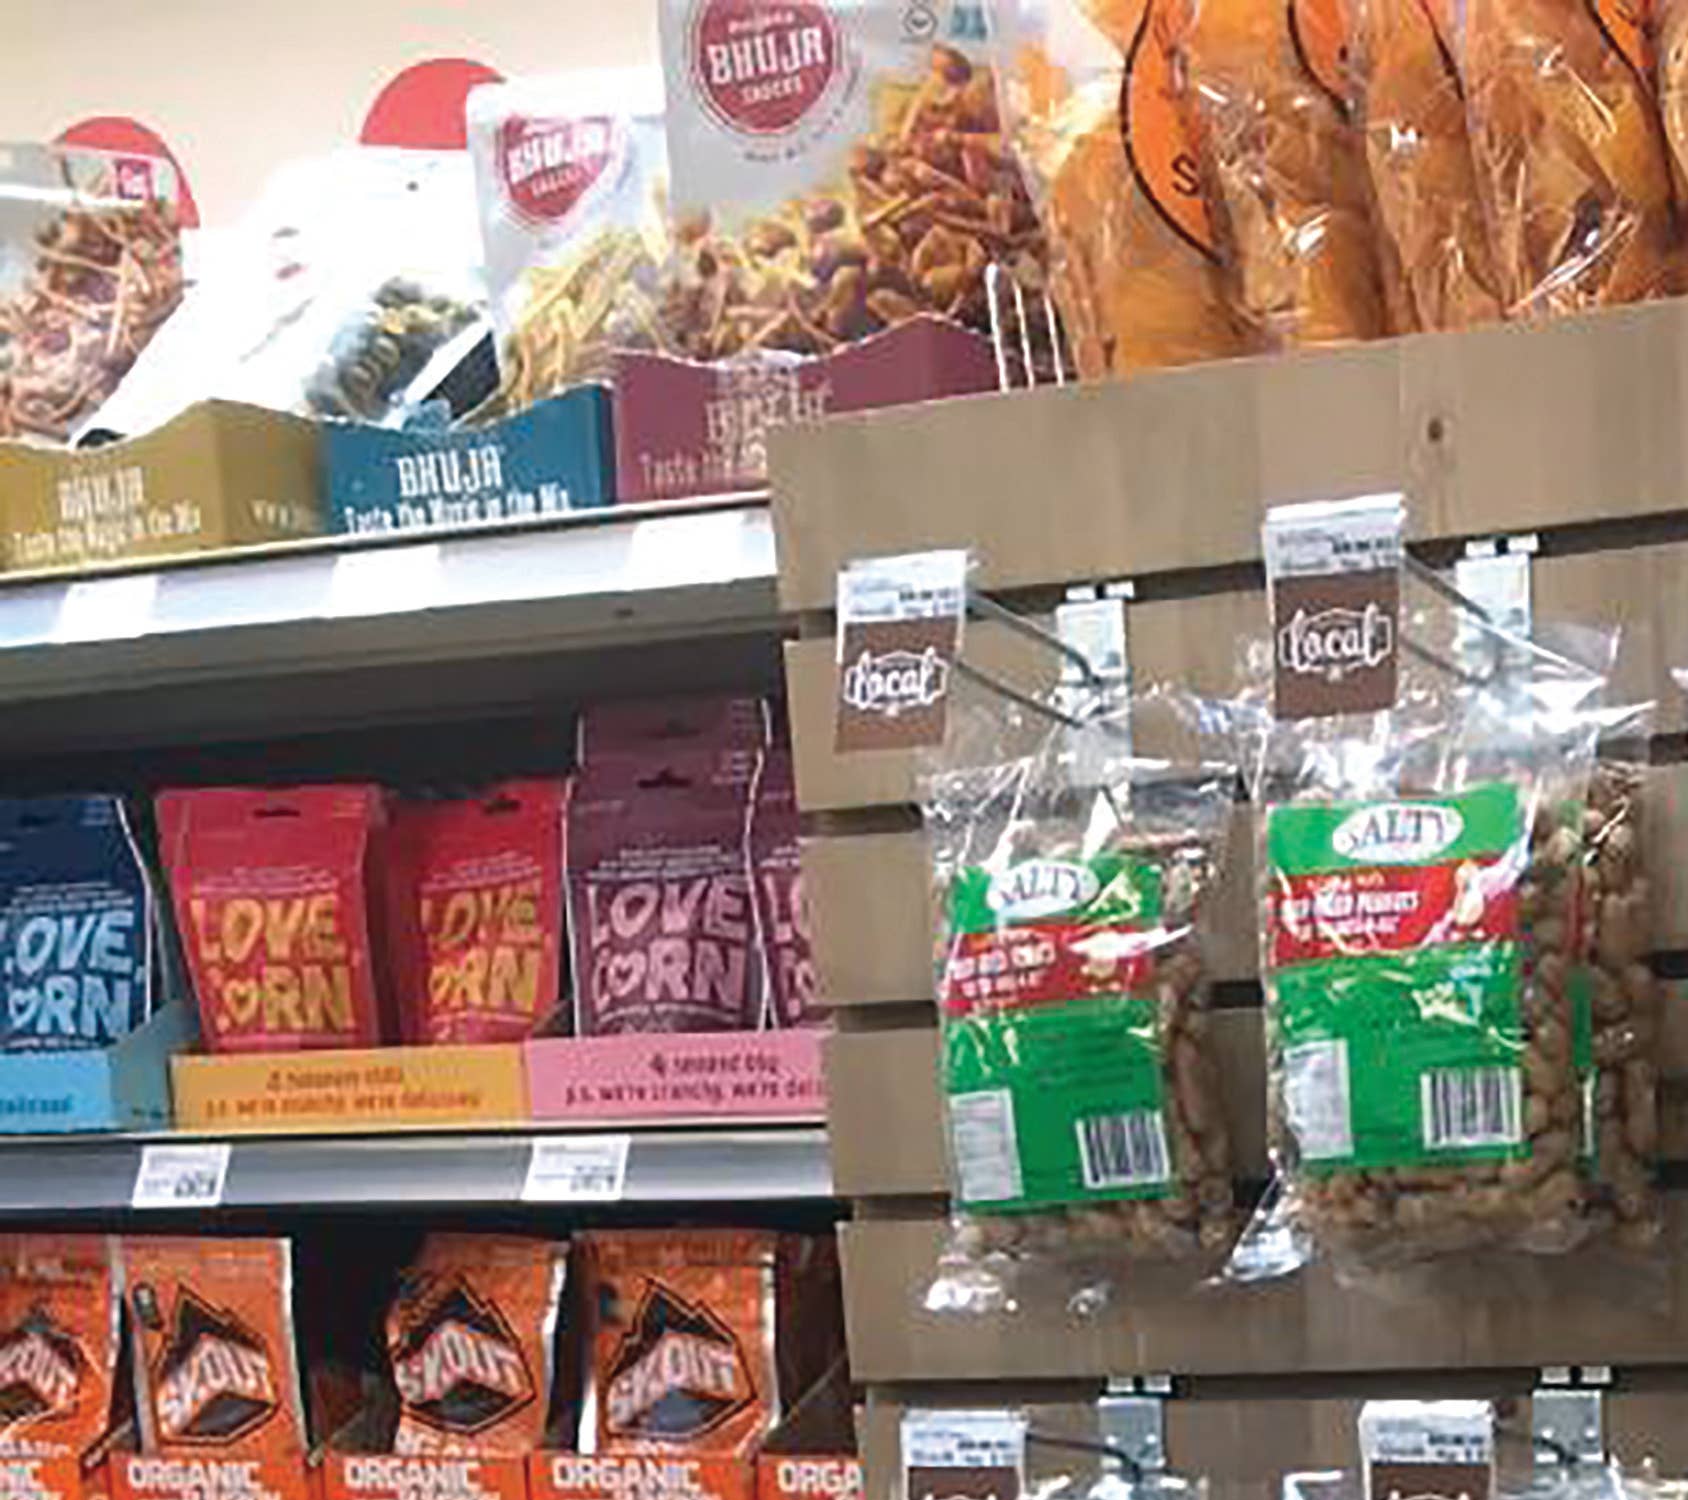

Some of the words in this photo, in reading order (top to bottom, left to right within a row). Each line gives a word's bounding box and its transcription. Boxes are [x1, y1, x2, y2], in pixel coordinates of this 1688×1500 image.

[707, 26, 826, 85] BHUJA
[399, 445, 502, 498] BHUJA
[1292, 602, 1379, 671] local
[851, 646, 933, 709] local
[191, 896, 345, 963] LOVE
[587, 876, 747, 945] LOVE
[127, 1461, 265, 1491] ORGANIC
[345, 1458, 479, 1490] ORGANIC
[553, 1458, 702, 1492] ORGANIC
[777, 1460, 864, 1492] ORGA
